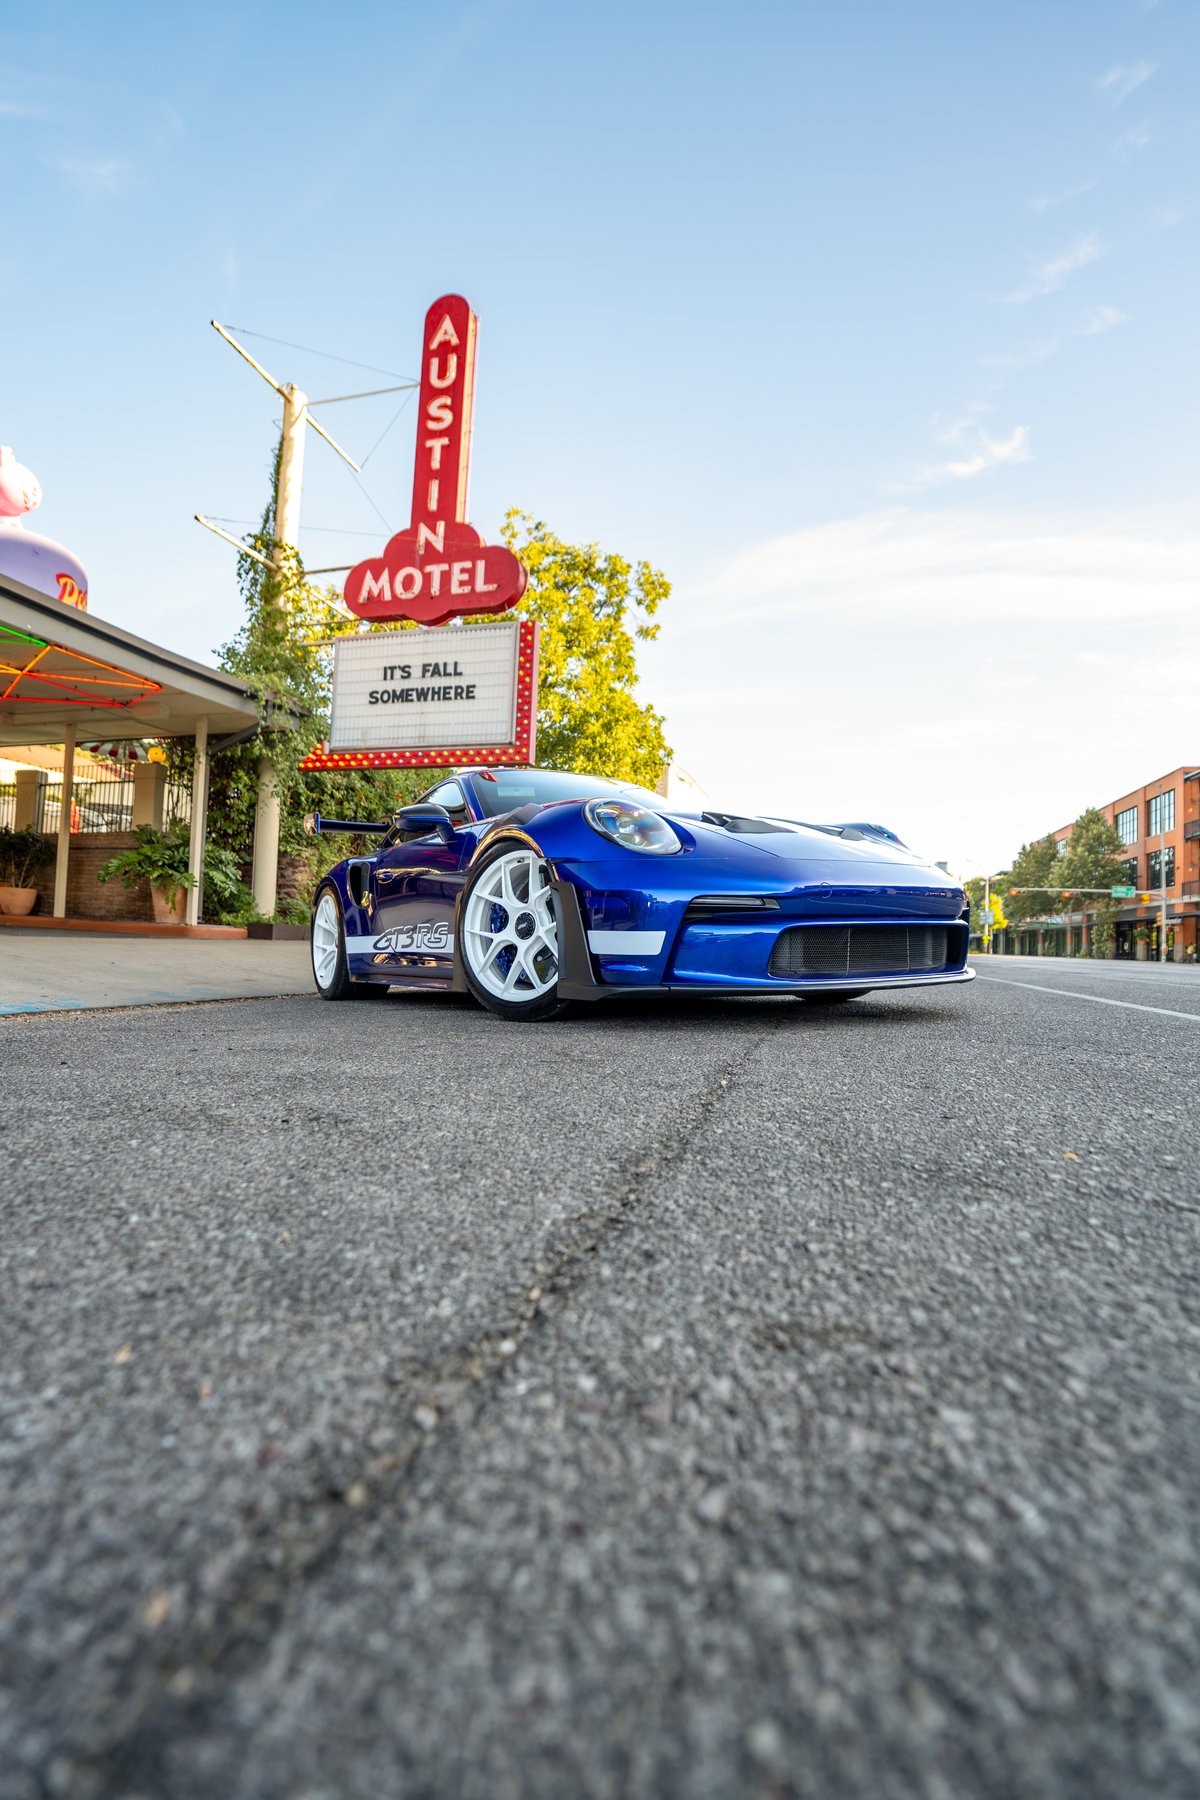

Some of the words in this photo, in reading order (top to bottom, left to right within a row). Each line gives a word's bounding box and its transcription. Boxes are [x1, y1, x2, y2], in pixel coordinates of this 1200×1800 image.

[417, 312, 460, 555] AUSTIN
[358, 559, 498, 604] MOTEL
[383, 664, 412, 680] IT'S
[421, 660, 463, 678] FALL
[368, 684, 476, 704] SOMEWHERE
